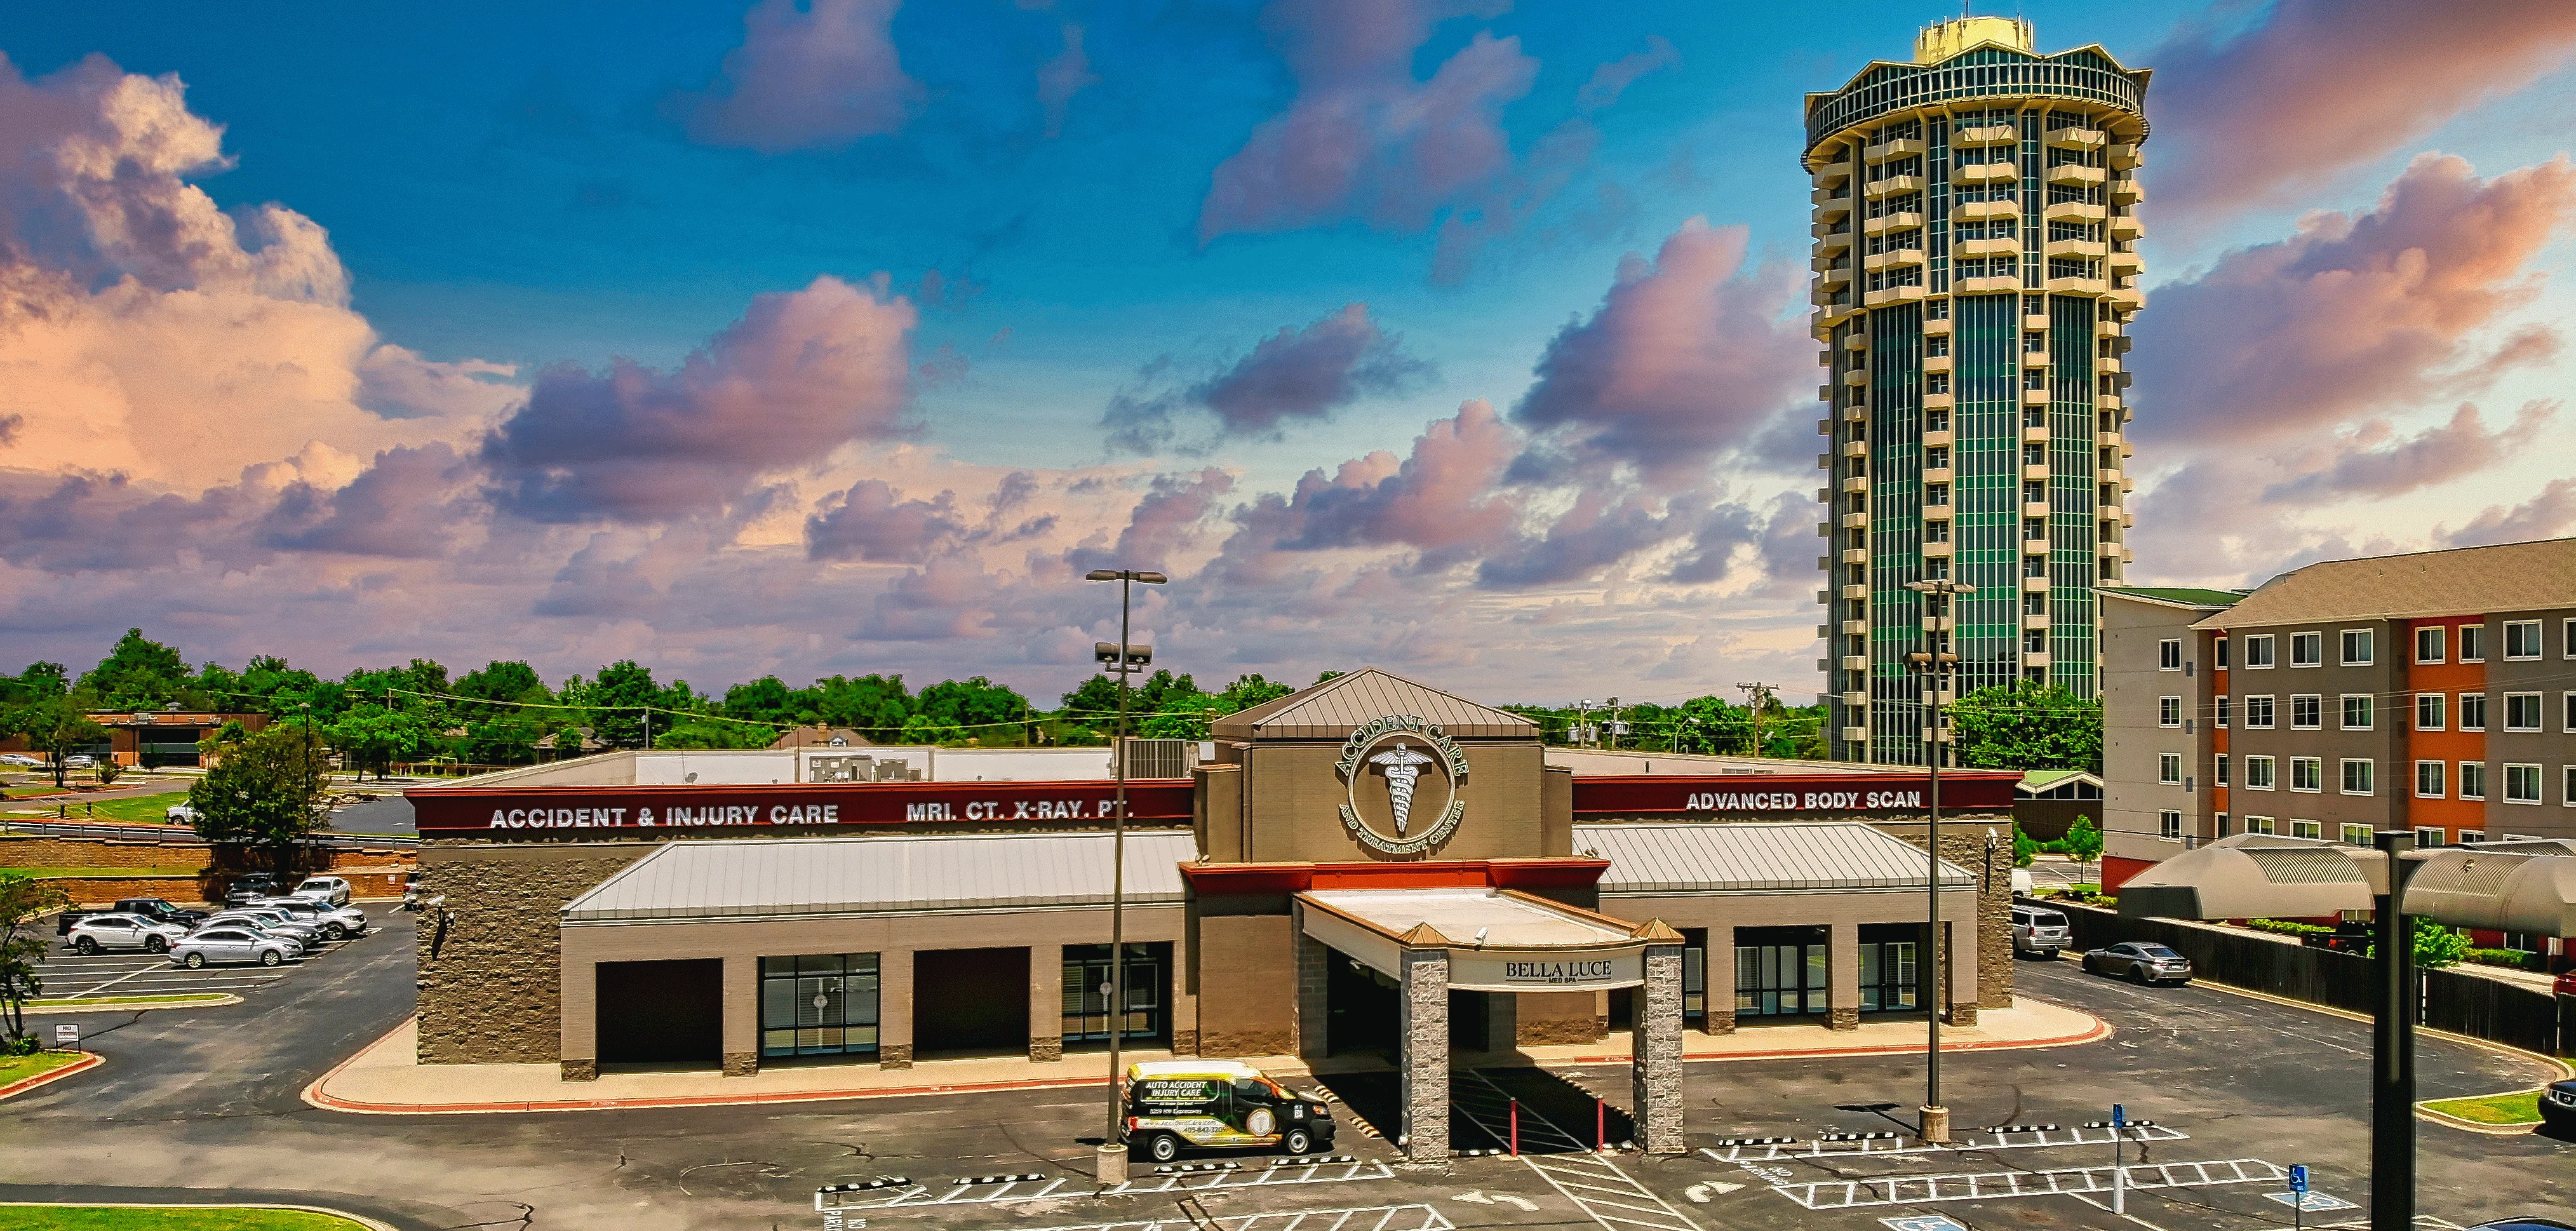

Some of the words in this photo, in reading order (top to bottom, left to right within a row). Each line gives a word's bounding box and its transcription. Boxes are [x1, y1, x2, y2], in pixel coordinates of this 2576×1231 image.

[1334, 715, 1423, 776] ACCIDENT
[1425, 724, 1470, 776] CARE
[1686, 793, 1797, 811] ADVANCED
[1804, 792, 1858, 809] BODY
[1866, 791, 1921, 808] SCAN
[490, 808, 626, 828] ACCIDENT
[637, 808, 655, 827] &
[667, 806, 759, 826] INJURY
[770, 805, 839, 824] CARE
[1339, 804, 1358, 830] AND
[1357, 828, 1428, 854] TREATMENT
[1430, 800, 1465, 845] CENTER
[1506, 962, 1564, 977] BELLA
[1569, 960, 1612, 977] LUCE
[1768, 1167, 1794, 1176] NO
[824, 1211, 843, 1231] PARKI
[847, 1219, 866, 1229] NO
